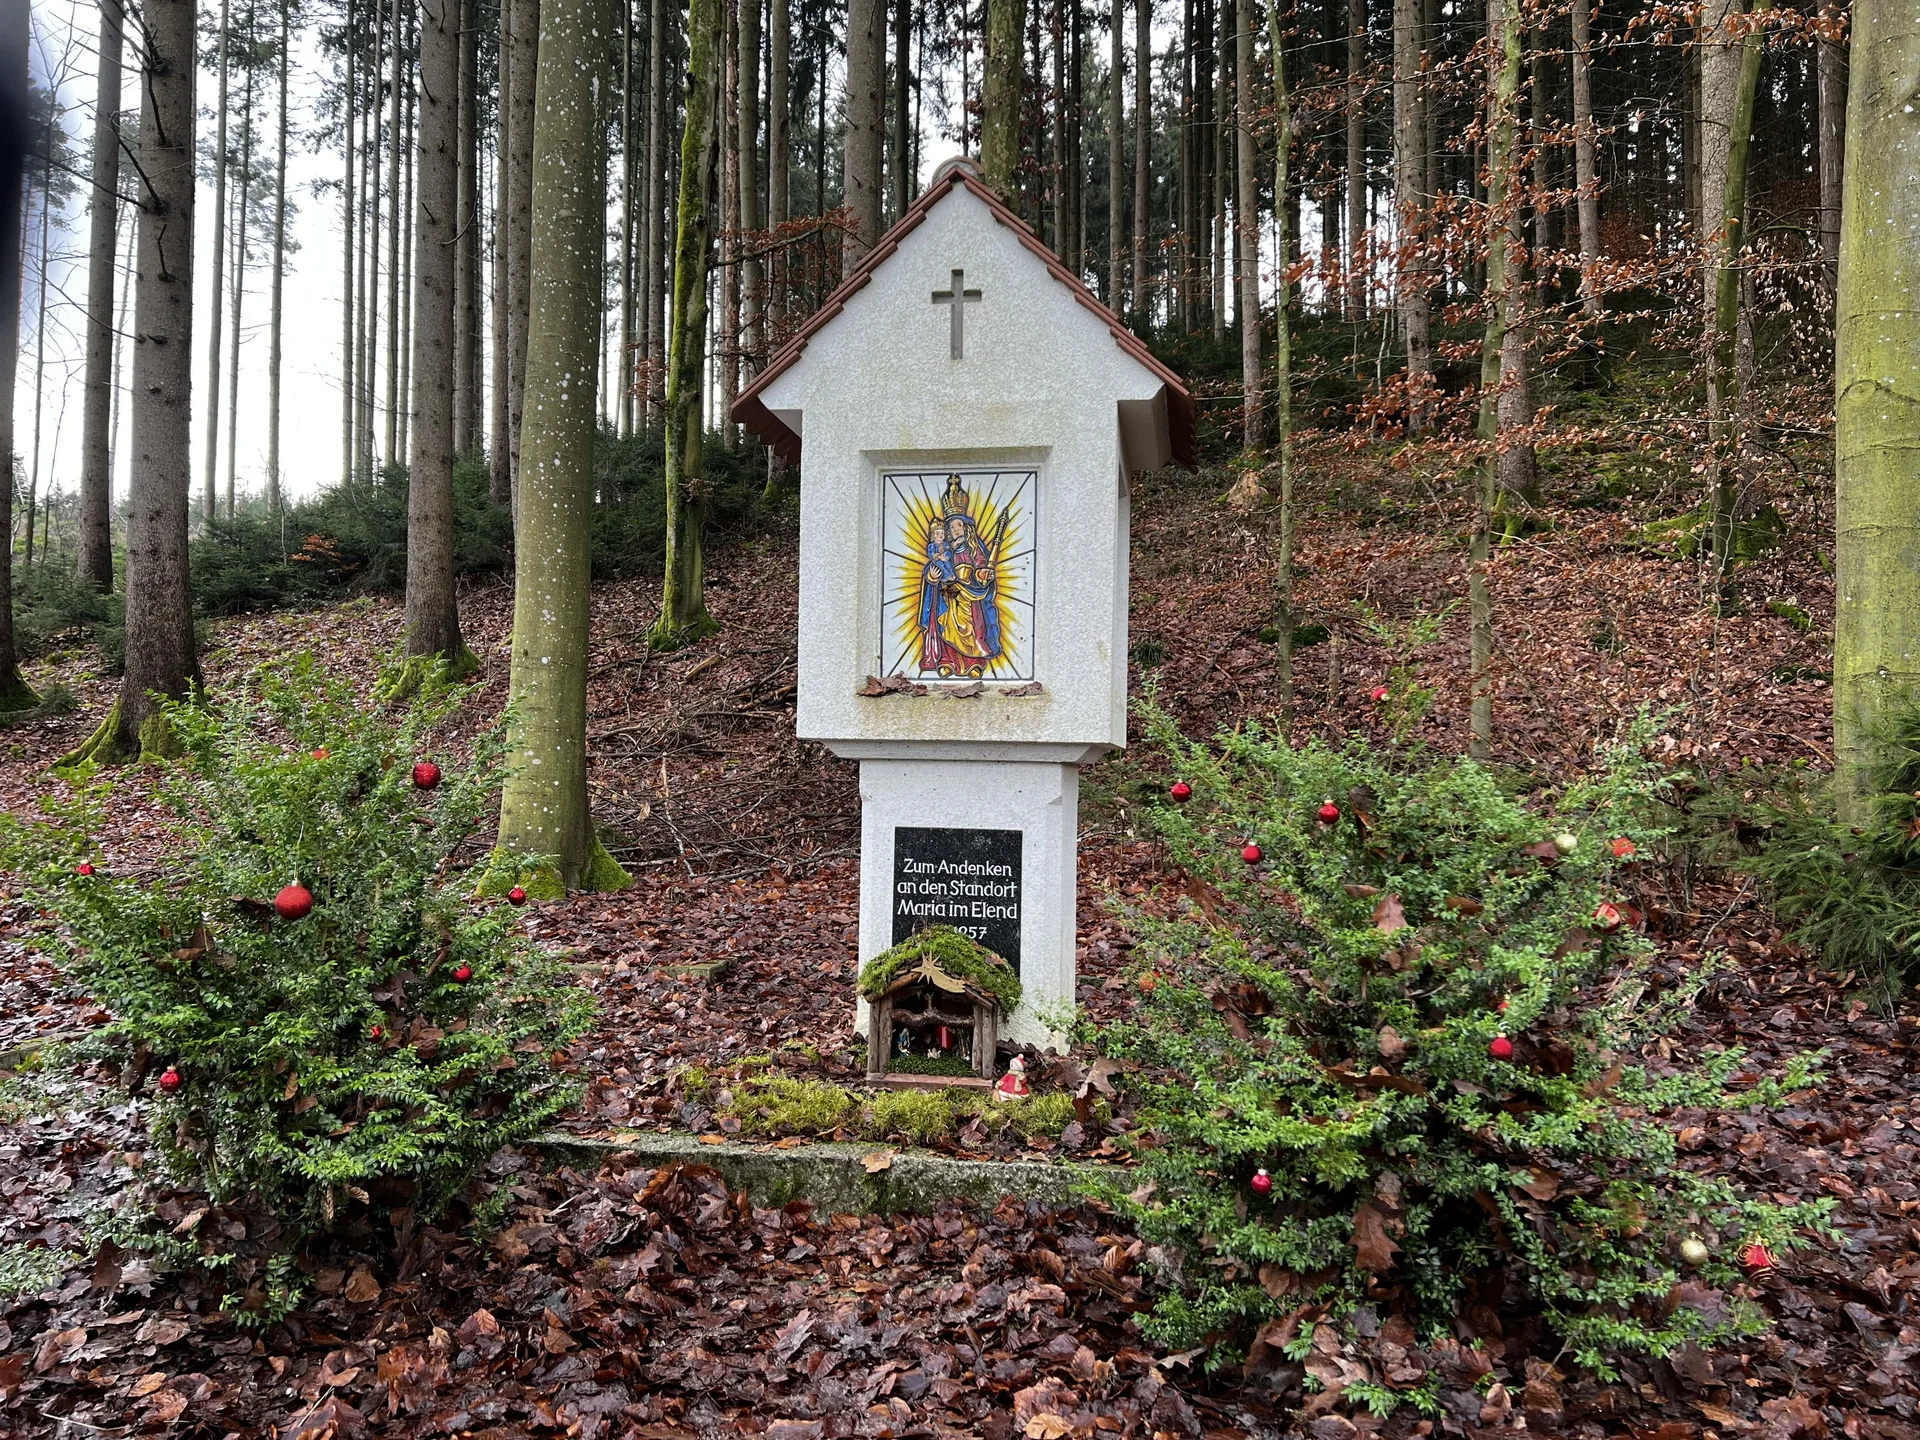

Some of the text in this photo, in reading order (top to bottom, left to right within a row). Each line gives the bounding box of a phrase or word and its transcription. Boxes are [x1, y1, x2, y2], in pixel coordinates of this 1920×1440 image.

[902, 858, 1013, 876] Zum Andenken
[897, 879, 1018, 898] an den Standort
[897, 899, 1018, 920] Maria im Elend
